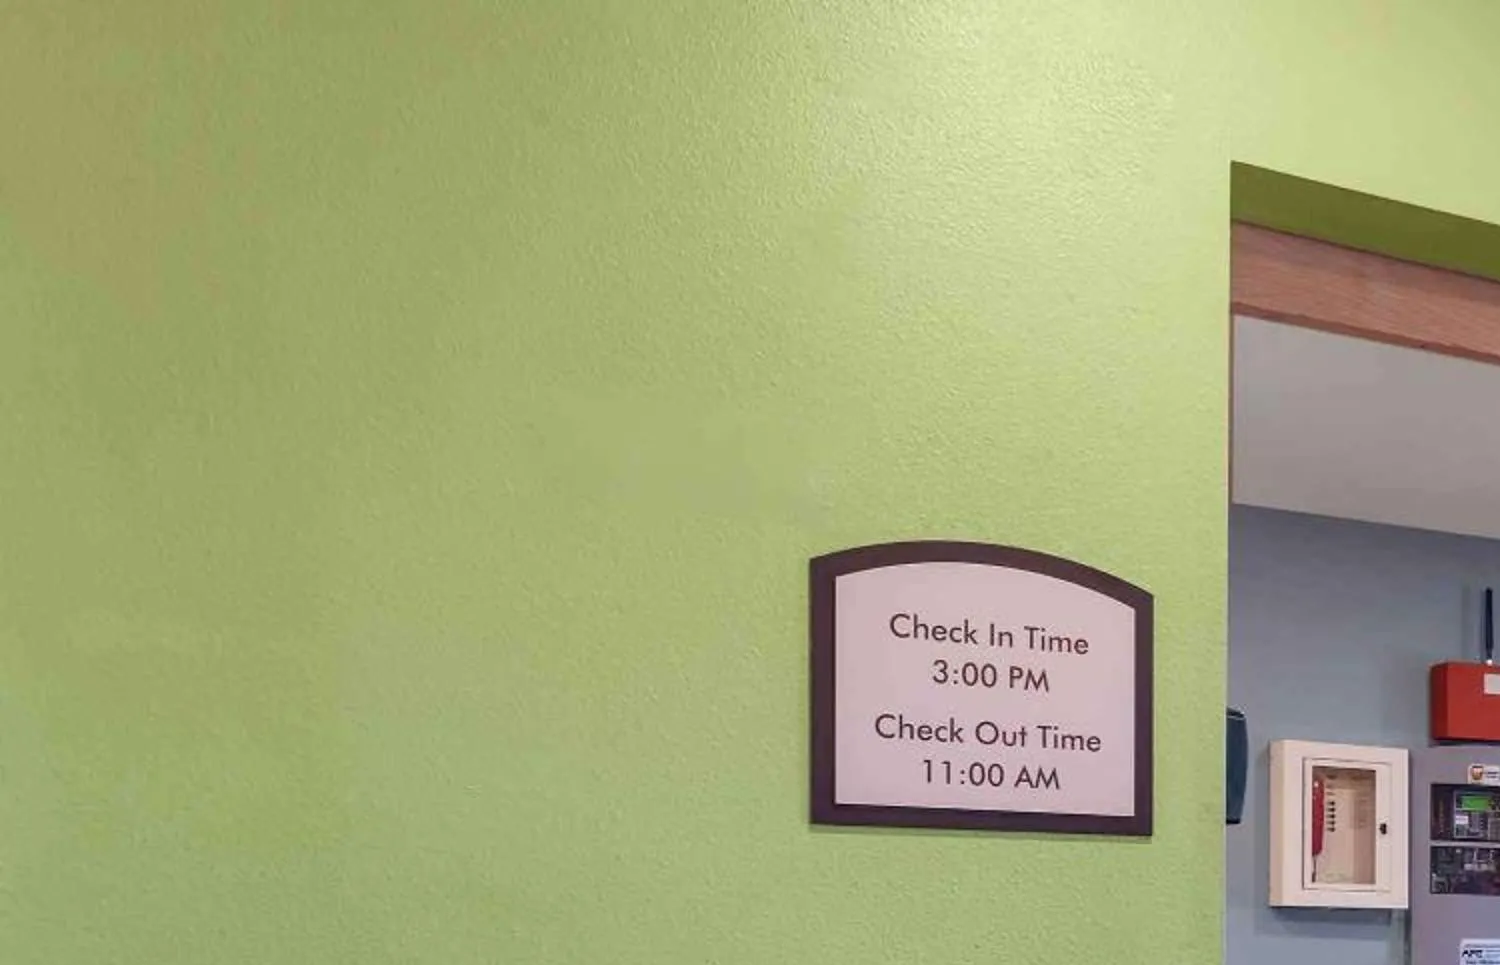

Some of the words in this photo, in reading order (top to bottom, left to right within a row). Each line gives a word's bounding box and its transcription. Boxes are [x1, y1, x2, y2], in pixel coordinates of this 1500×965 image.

[890, 612, 978, 646] Check
[989, 623, 1014, 649] In
[1023, 626, 1089, 655] Time
[931, 659, 998, 688] 3:00
[1008, 666, 1050, 693] PM
[874, 713, 964, 744] Check
[974, 721, 1028, 748] Out
[1036, 725, 1102, 752] Time
[922, 759, 1005, 788] 11:00
[1013, 765, 1061, 791] AM
